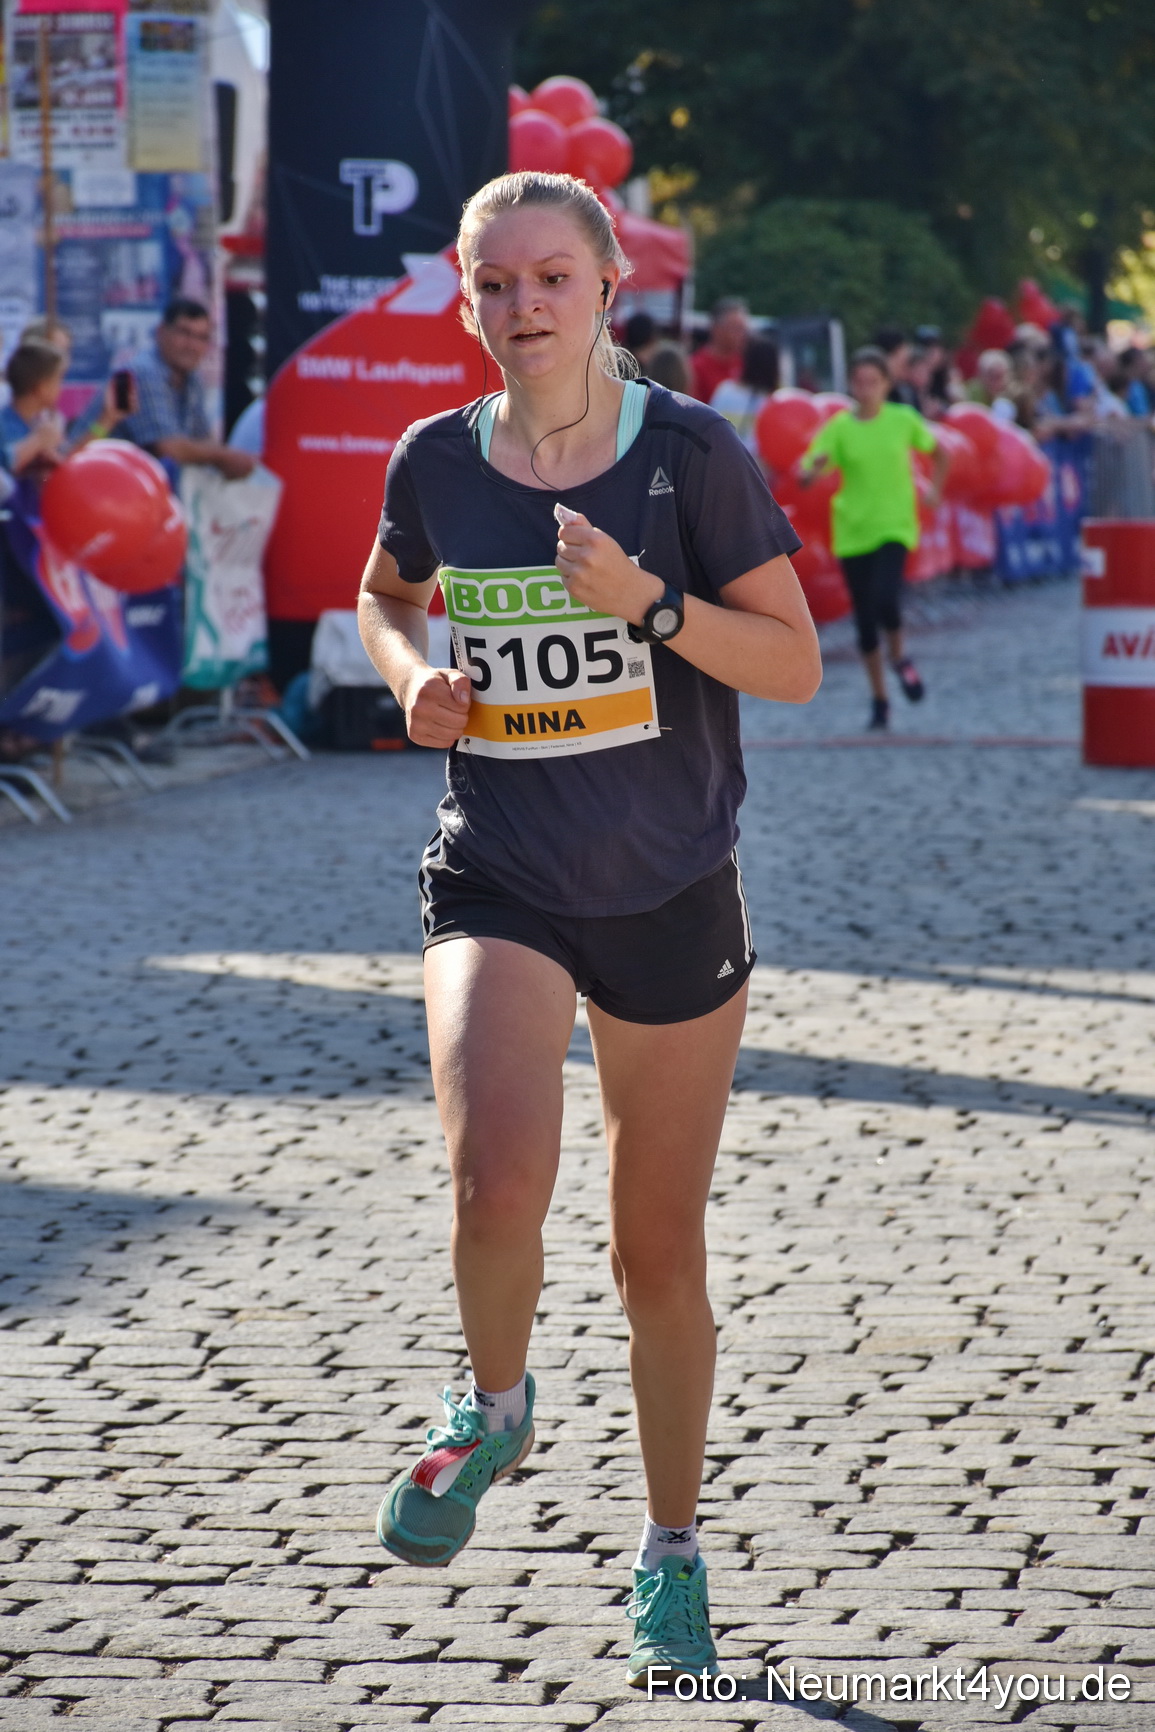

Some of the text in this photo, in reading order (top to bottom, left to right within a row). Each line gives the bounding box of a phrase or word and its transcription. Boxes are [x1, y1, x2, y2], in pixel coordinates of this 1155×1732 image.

[355, 357, 466, 386] Laufsport
[648, 486, 675, 497] Reebok
[464, 629, 624, 692] 5105
[503, 709, 587, 736] NINA
[717, 967, 735, 979] adidas
